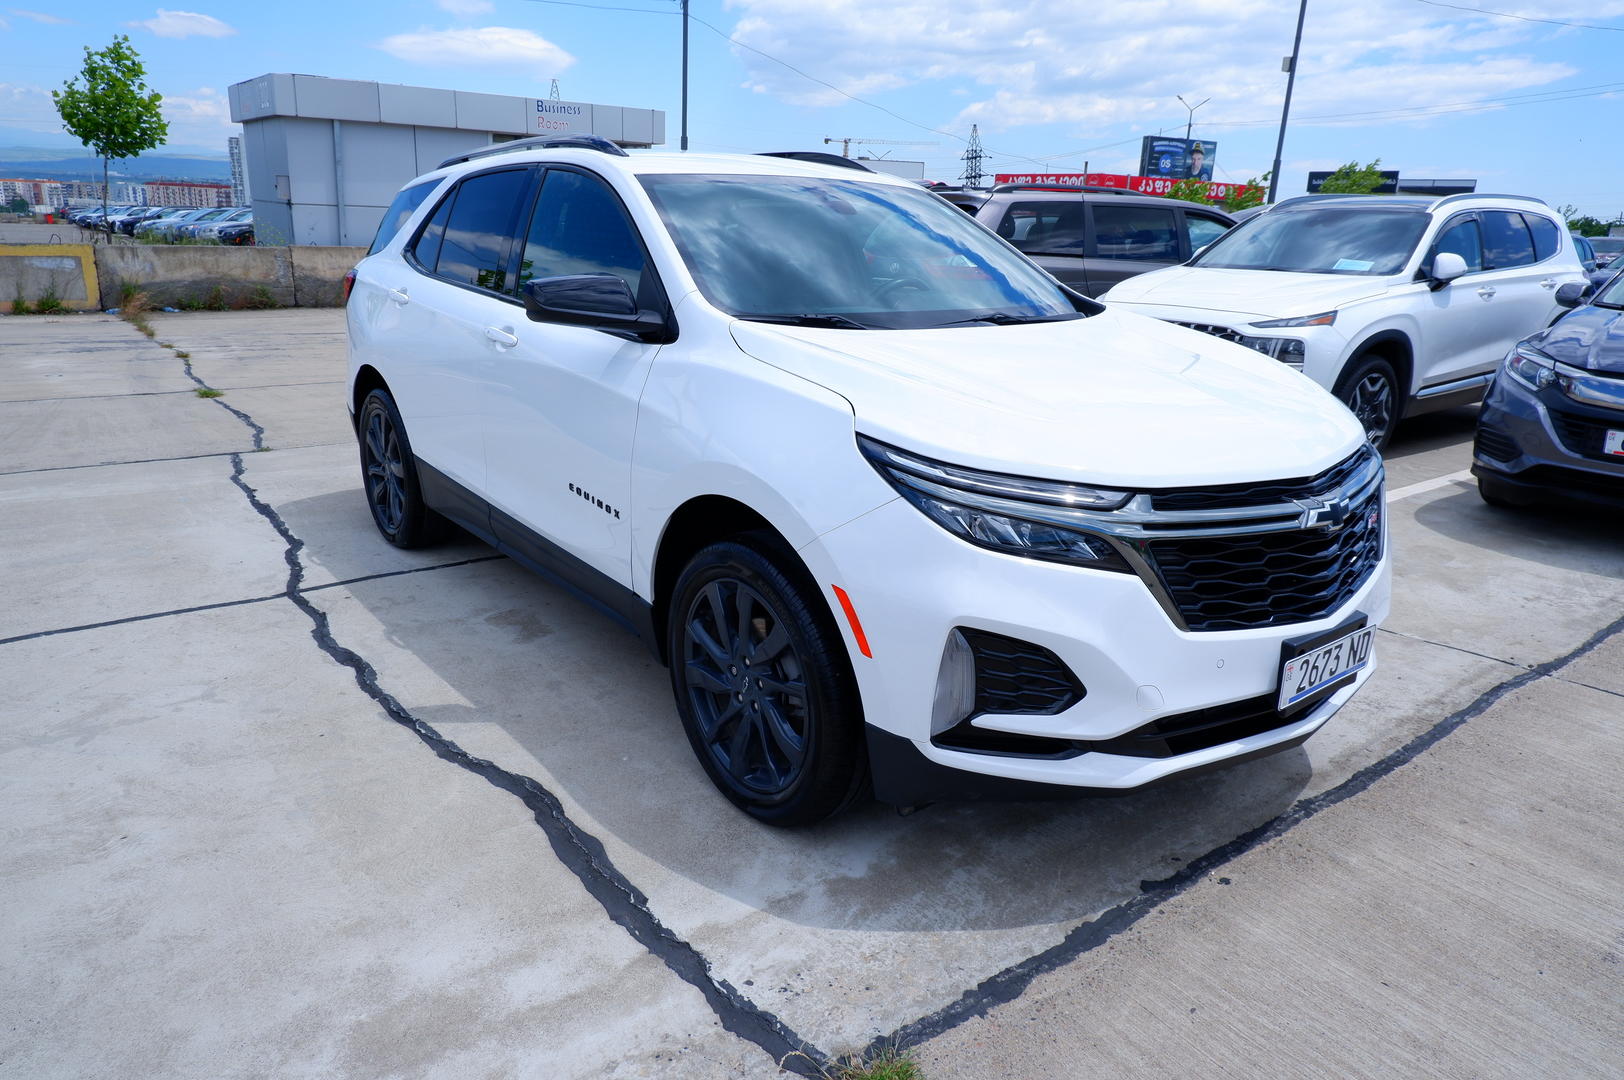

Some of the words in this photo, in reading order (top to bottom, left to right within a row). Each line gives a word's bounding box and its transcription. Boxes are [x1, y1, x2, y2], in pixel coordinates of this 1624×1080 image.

[536, 100, 581, 115] Business
[537, 116, 569, 130] Room
[1138, 179, 1172, 193] კაფე
[568, 482, 620, 520] EQUINOX
[1296, 643, 1343, 694] 2673
[1346, 630, 1371, 669] ND
